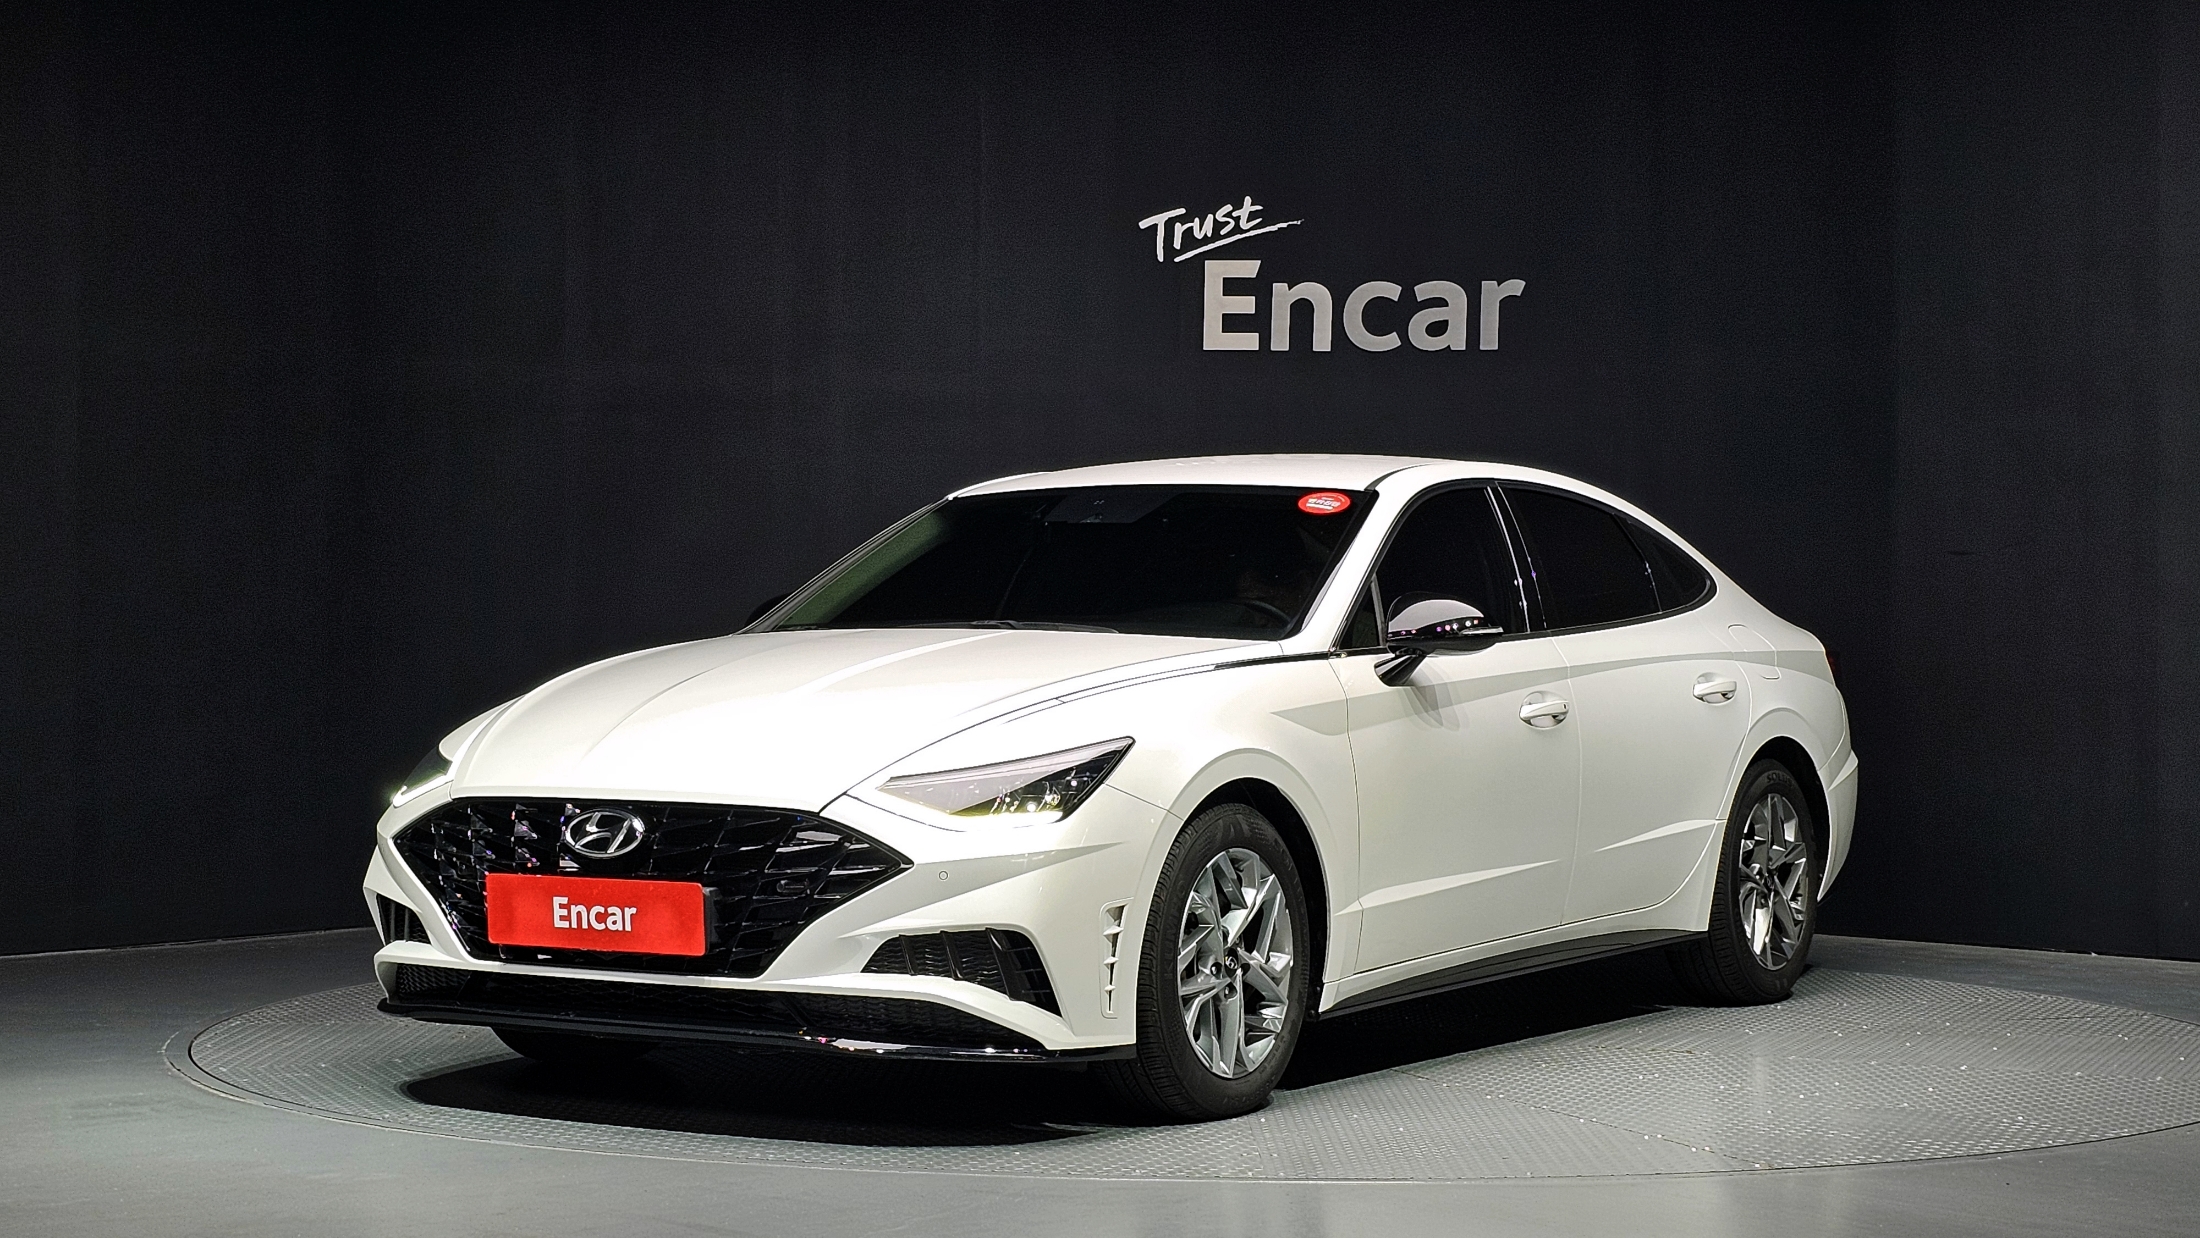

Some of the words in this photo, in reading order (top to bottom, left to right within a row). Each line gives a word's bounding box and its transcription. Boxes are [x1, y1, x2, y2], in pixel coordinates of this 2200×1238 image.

[1138, 195, 1264, 262] Trust
[1202, 259, 1526, 352] Encar
[552, 896, 638, 932] Encar
